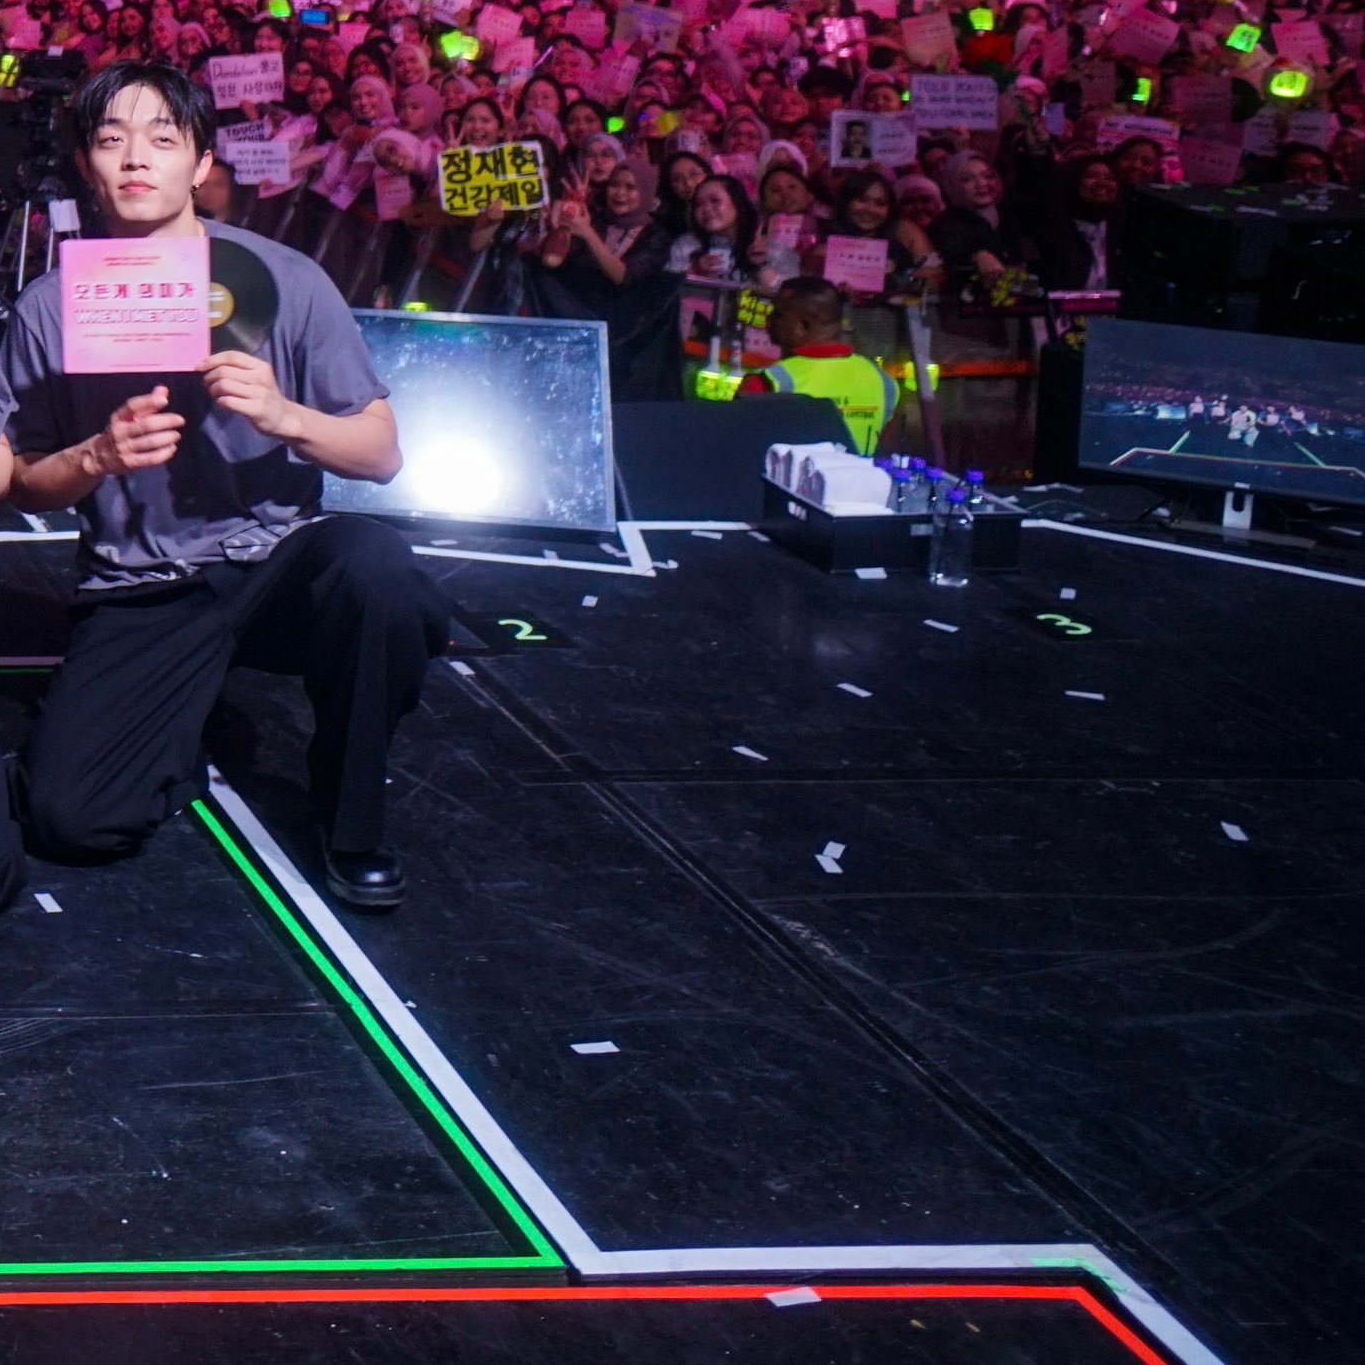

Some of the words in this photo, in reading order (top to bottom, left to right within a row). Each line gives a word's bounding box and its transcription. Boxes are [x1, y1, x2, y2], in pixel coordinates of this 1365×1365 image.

[442, 145, 539, 183] 정재현
[445, 177, 545, 211] 건강제일
[498, 619, 547, 640] 2
[1036, 613, 1092, 634] 3
